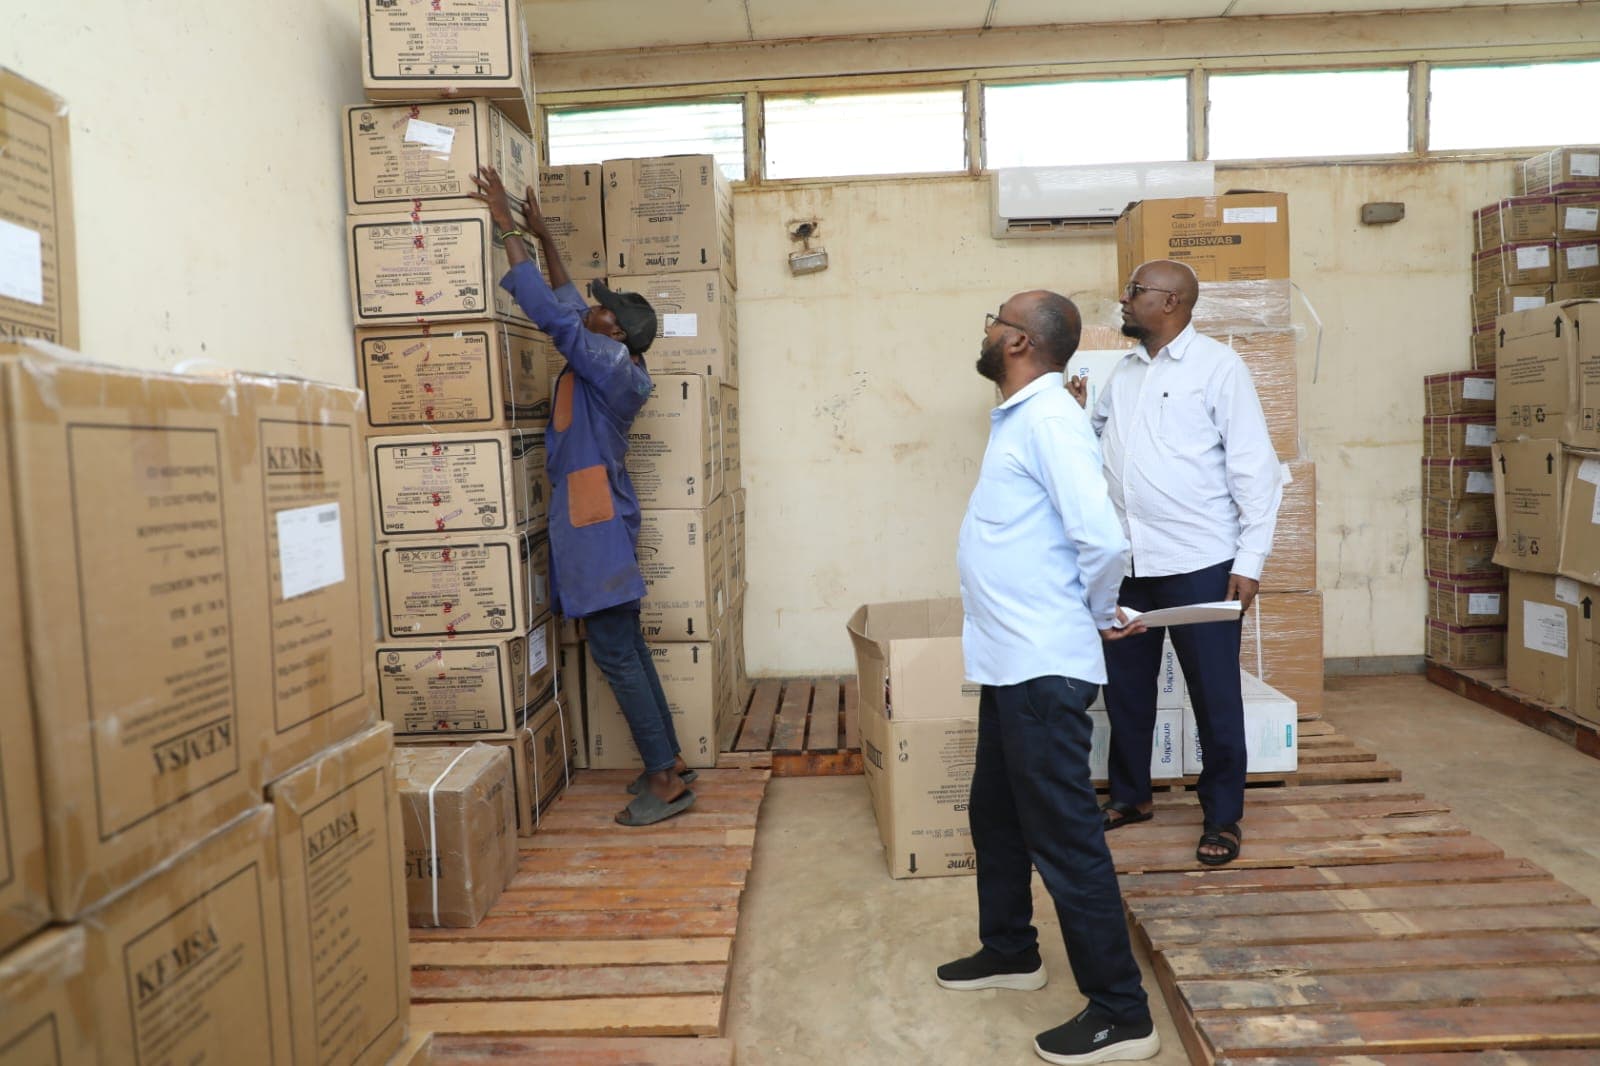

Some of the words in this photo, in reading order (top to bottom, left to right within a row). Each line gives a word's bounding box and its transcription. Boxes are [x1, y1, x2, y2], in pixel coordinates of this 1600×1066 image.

[448, 107, 470, 116] 20ml
[1171, 235, 1233, 248] MEDISWAB
[266, 445, 323, 471] KEMSA
[650, 647, 668, 657] yme
[152, 721, 233, 777] KEMSA
[307, 811, 358, 859] KEMSA
[135, 924, 219, 1000] KEMSA
